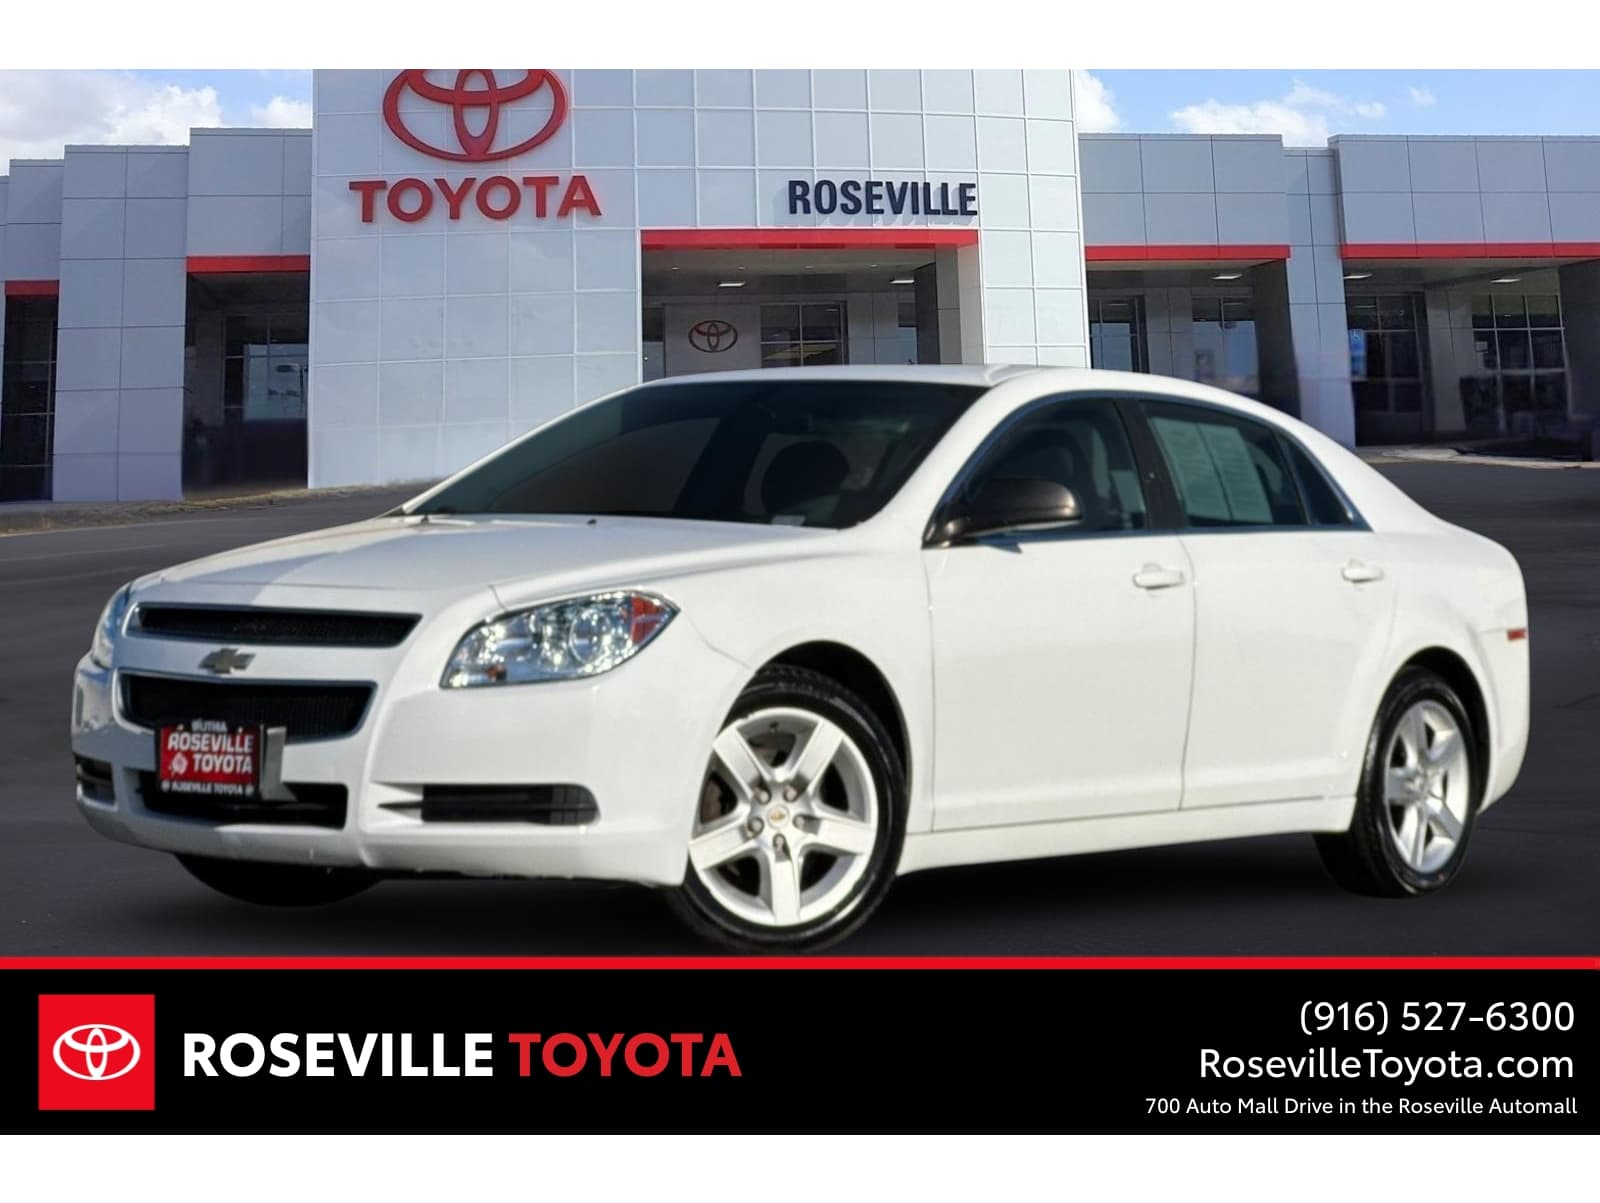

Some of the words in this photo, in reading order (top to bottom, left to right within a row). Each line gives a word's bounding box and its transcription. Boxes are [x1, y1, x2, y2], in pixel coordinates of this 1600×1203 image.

[350, 175, 602, 223] TOYOTA
[788, 179, 978, 216] ROSEVILLE
[168, 732, 254, 753] ROSEVILLE
[193, 754, 253, 774] TOYOTA
